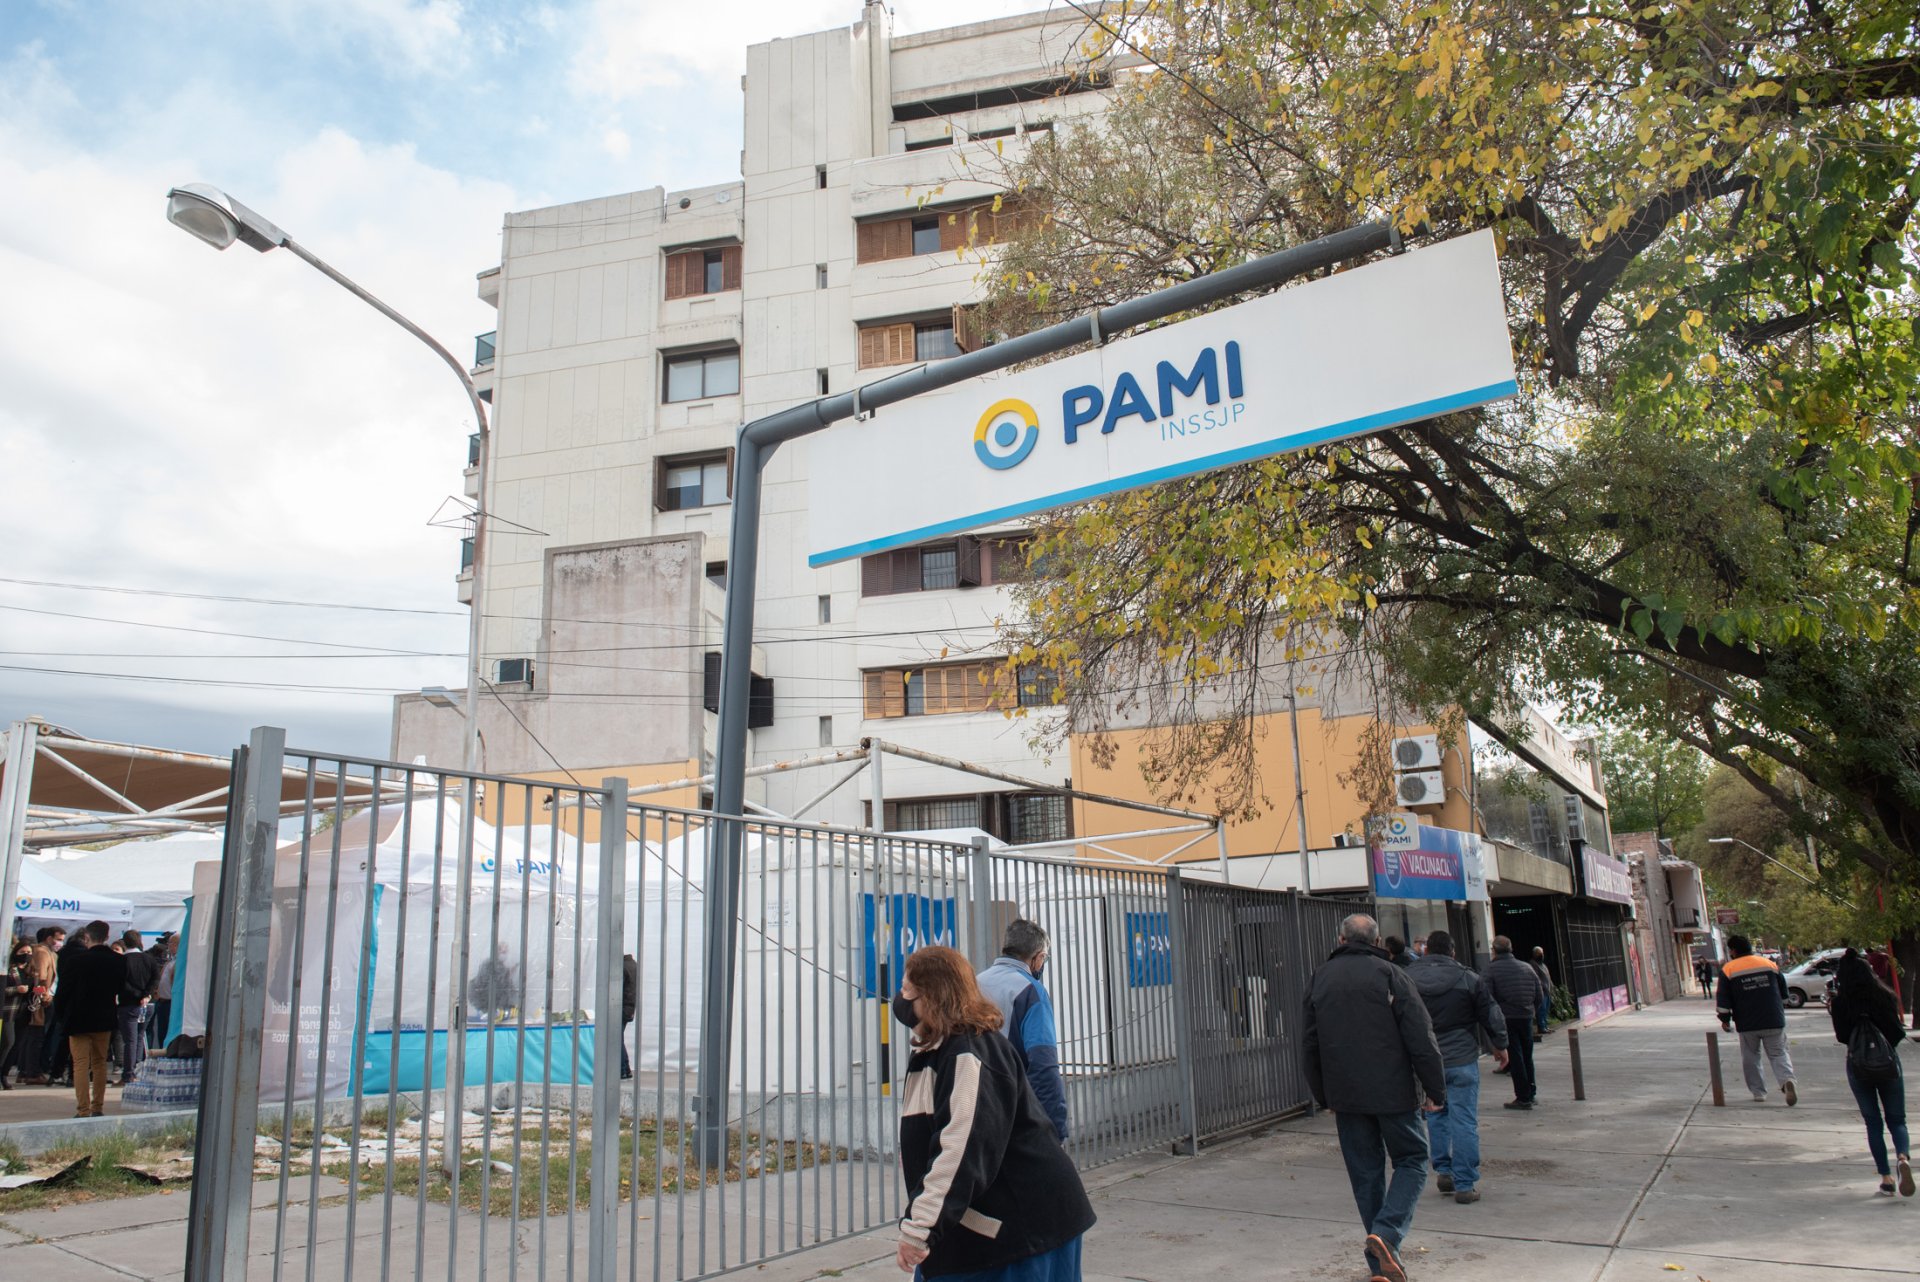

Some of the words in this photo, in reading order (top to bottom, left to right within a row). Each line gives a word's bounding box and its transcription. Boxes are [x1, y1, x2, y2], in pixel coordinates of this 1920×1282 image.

[1063, 340, 1244, 445] PAMI
[1161, 403, 1245, 441] INSSJP
[1387, 836, 1411, 845] PAMI
[41, 898, 80, 911] PAMI
